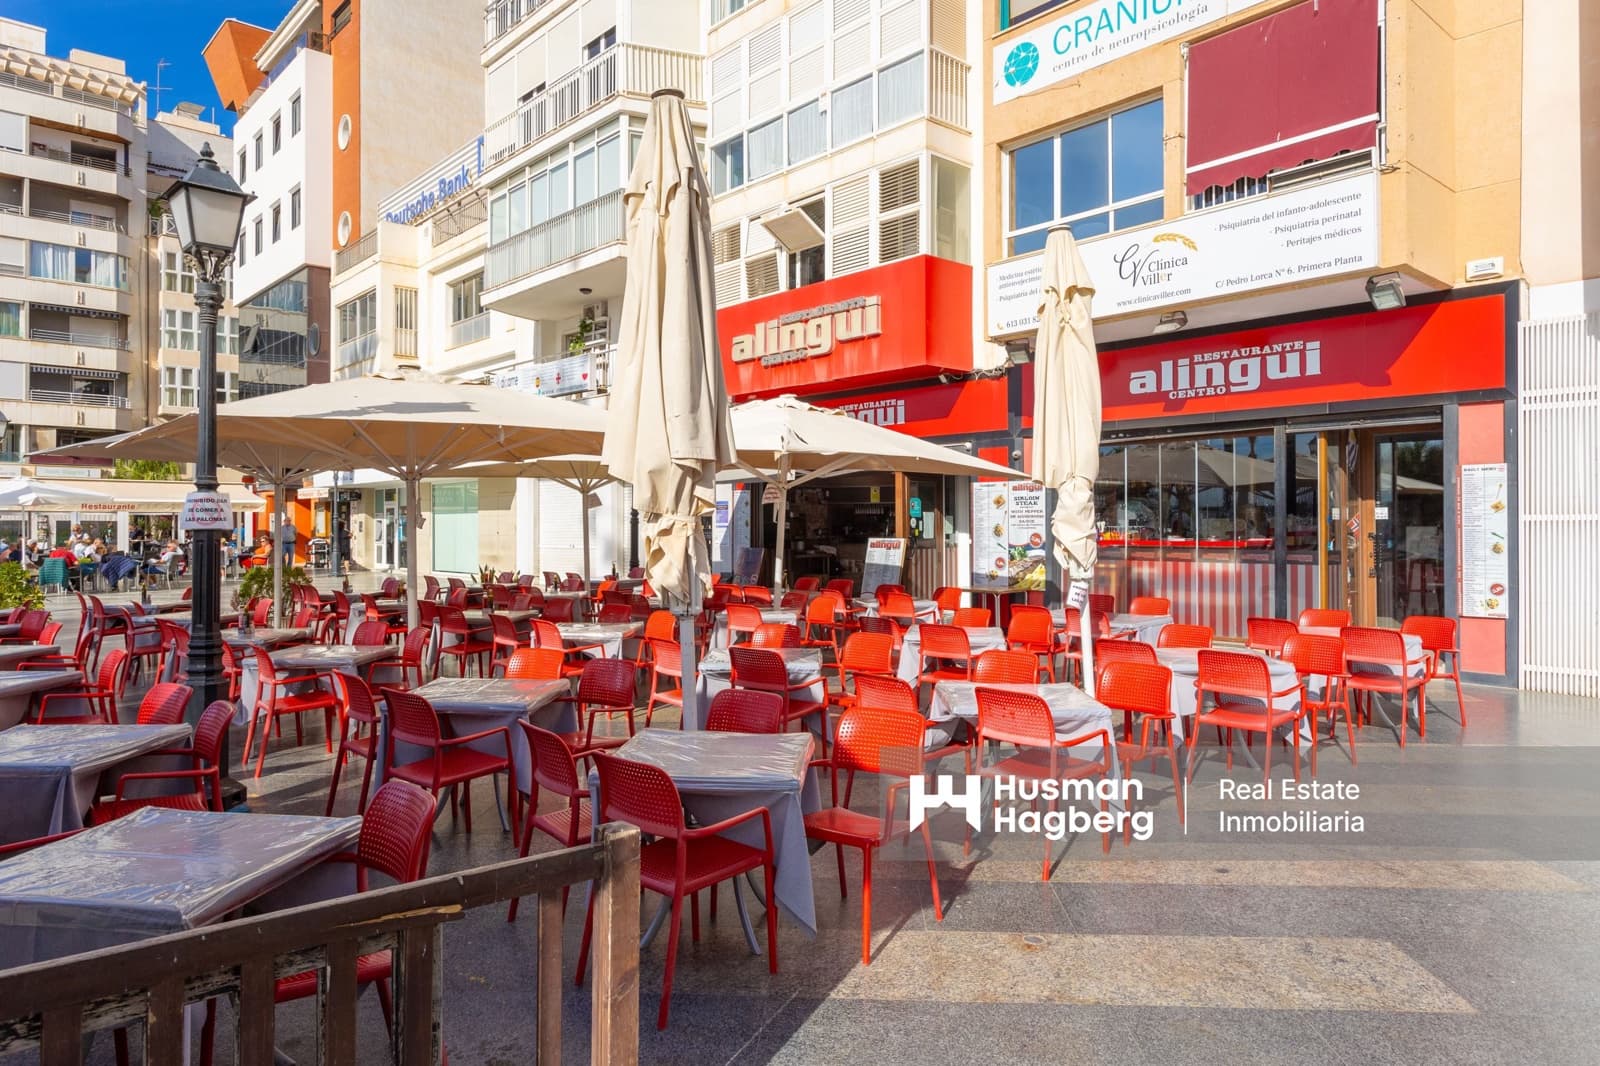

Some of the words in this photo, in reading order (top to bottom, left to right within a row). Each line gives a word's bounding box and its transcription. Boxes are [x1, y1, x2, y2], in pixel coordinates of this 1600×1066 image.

[1053, 53, 1088, 73] centro
[1091, 45, 1105, 57] de
[438, 164, 469, 202] Bank
[1262, 212, 1274, 222] del
[1276, 192, 1361, 219] infanto-adolescente
[1321, 208, 1361, 226] perinatal
[1286, 234, 1322, 248] Peritajes
[1324, 226, 1362, 240] médicos
[1148, 256, 1188, 273] Clínica
[1226, 276, 1248, 287] Pedro
[1250, 272, 1273, 282] Lorca
[1297, 261, 1332, 273] Primera
[1334, 254, 1363, 266] Planta
[1141, 272, 1173, 287] Viller
[731, 296, 882, 363] alingui
[1006, 319, 1018, 329] 613
[1193, 340, 1304, 363] RESTAURANTE
[1129, 341, 1321, 395] alingui
[1168, 386, 1227, 400] CENTRO
